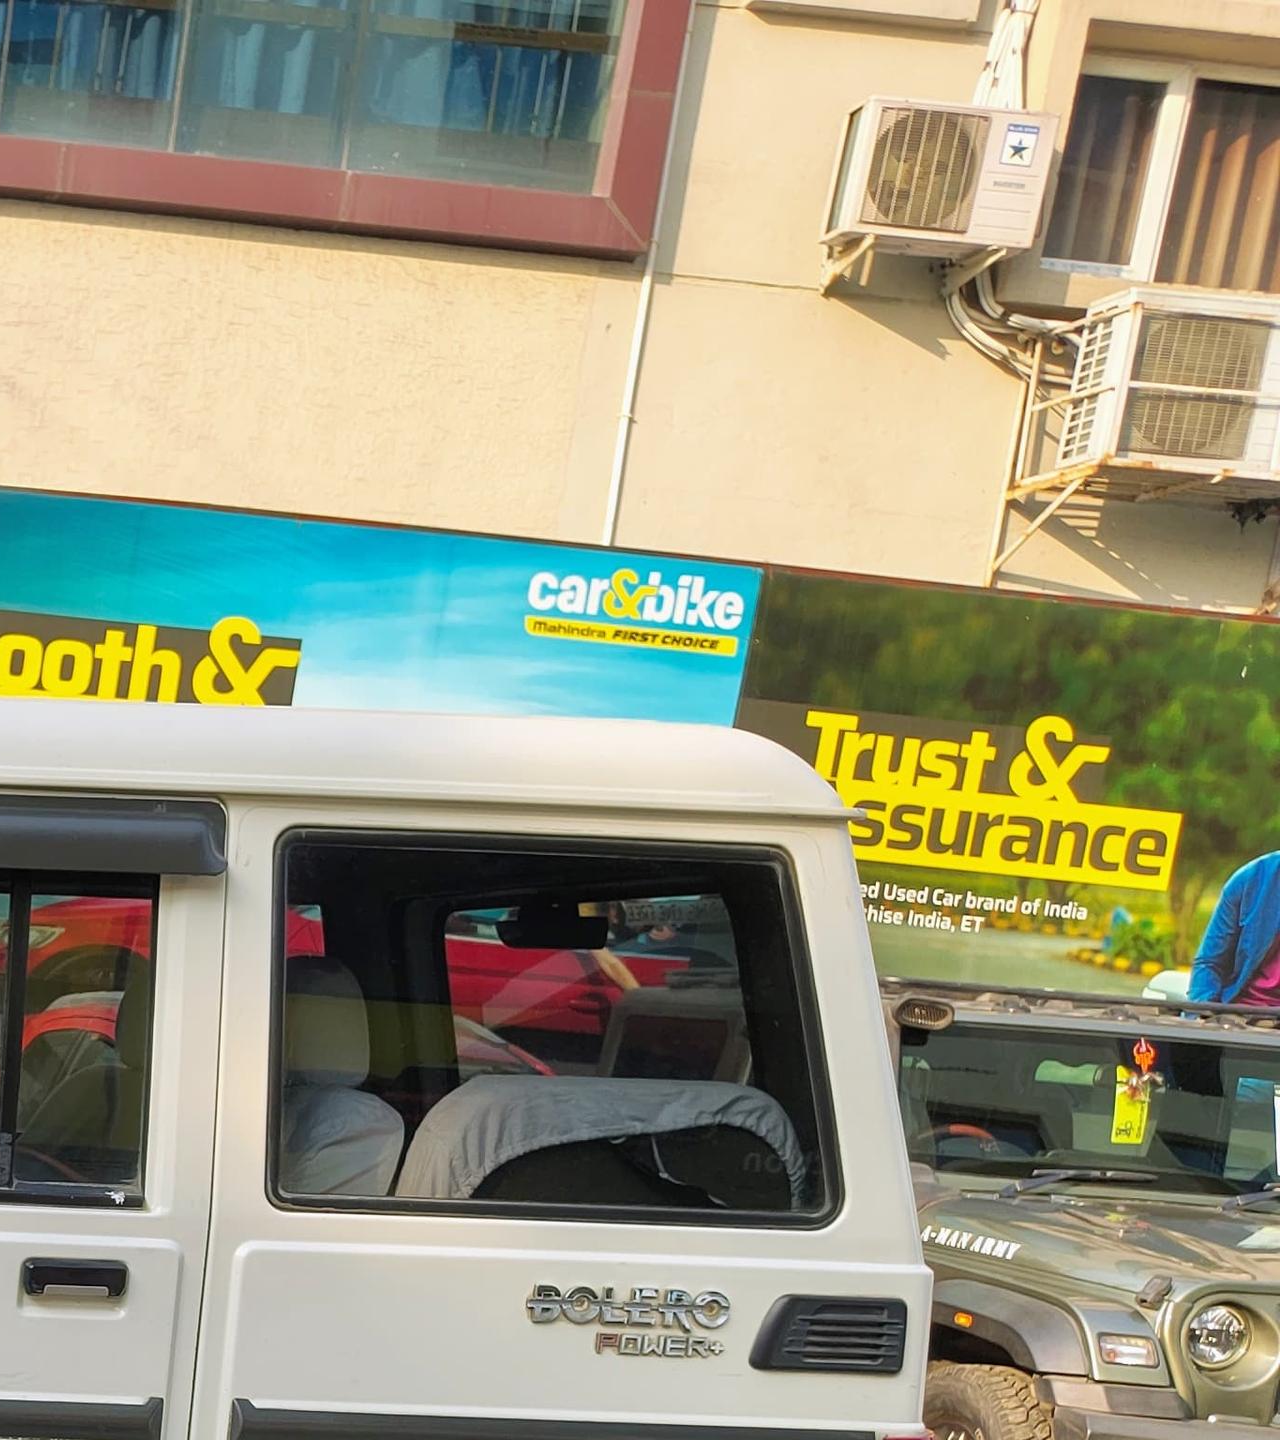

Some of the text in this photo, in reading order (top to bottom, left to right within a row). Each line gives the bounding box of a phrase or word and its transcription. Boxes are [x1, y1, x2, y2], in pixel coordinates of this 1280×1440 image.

[527, 568, 745, 631] car&bike
[531, 620, 721, 651] Mahindra FIRST CHOICE
[191, 616, 302, 706] &
[804, 710, 1111, 804] Trust &
[851, 798, 1169, 876] ssurance
[883, 884, 929, 904] Used
[932, 887, 959, 908] Car
[965, 891, 1018, 914] brand
[1021, 897, 1040, 915] of
[1043, 899, 1089, 921] India
[907, 908, 956, 932] India,
[960, 914, 986, 934] ET
[969, 1235, 1022, 1260] ARMY
[526, 1284, 731, 1333] BOLERO
[594, 1331, 726, 1359] POWER+
